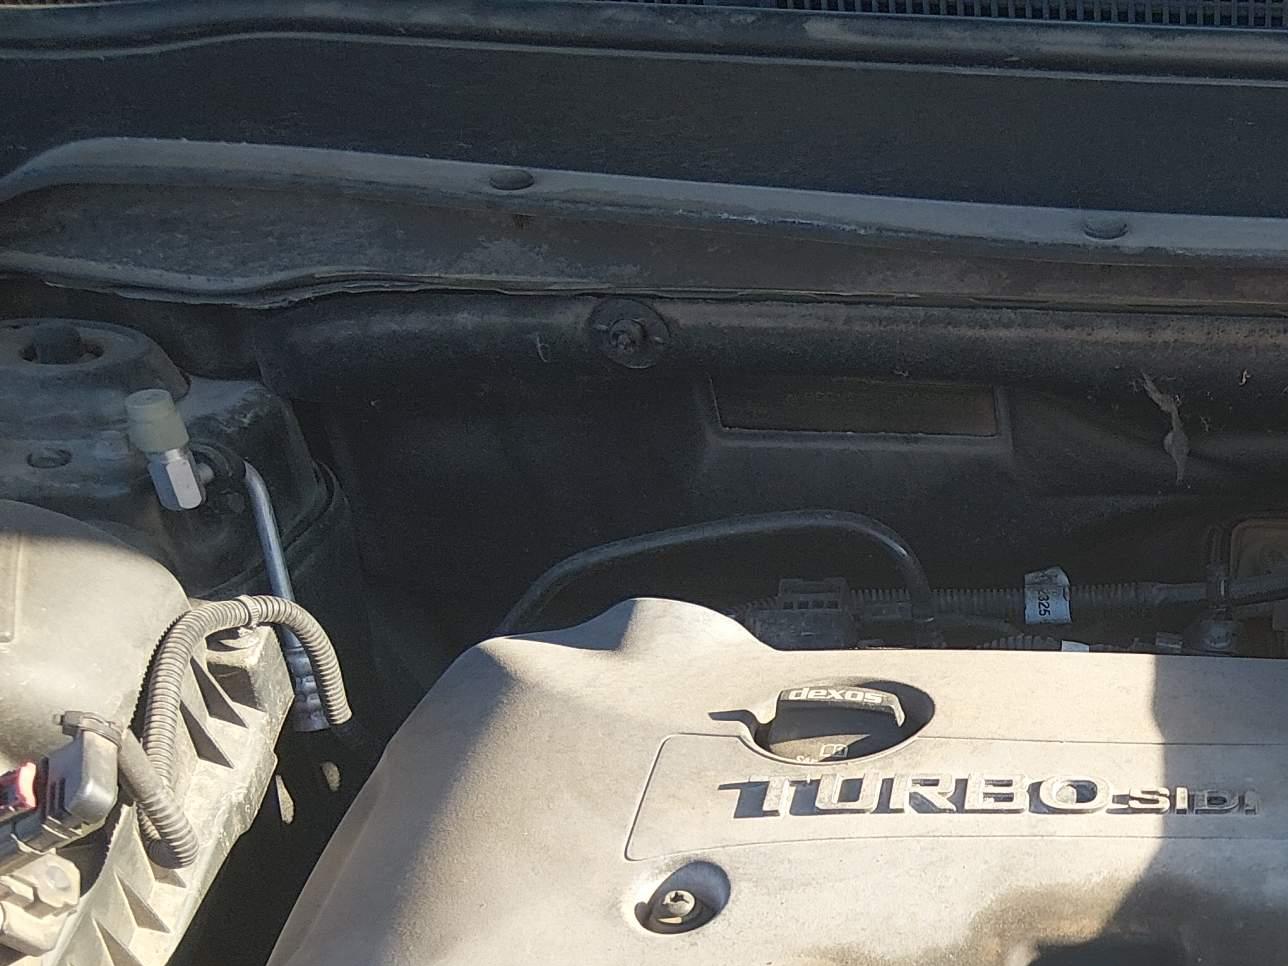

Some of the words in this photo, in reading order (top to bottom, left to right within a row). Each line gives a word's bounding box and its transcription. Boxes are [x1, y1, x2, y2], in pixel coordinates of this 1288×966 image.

[788, 687, 883, 704] dexos
[718, 771, 1113, 819] TURBO
[1126, 786, 1258, 815] SIDI
